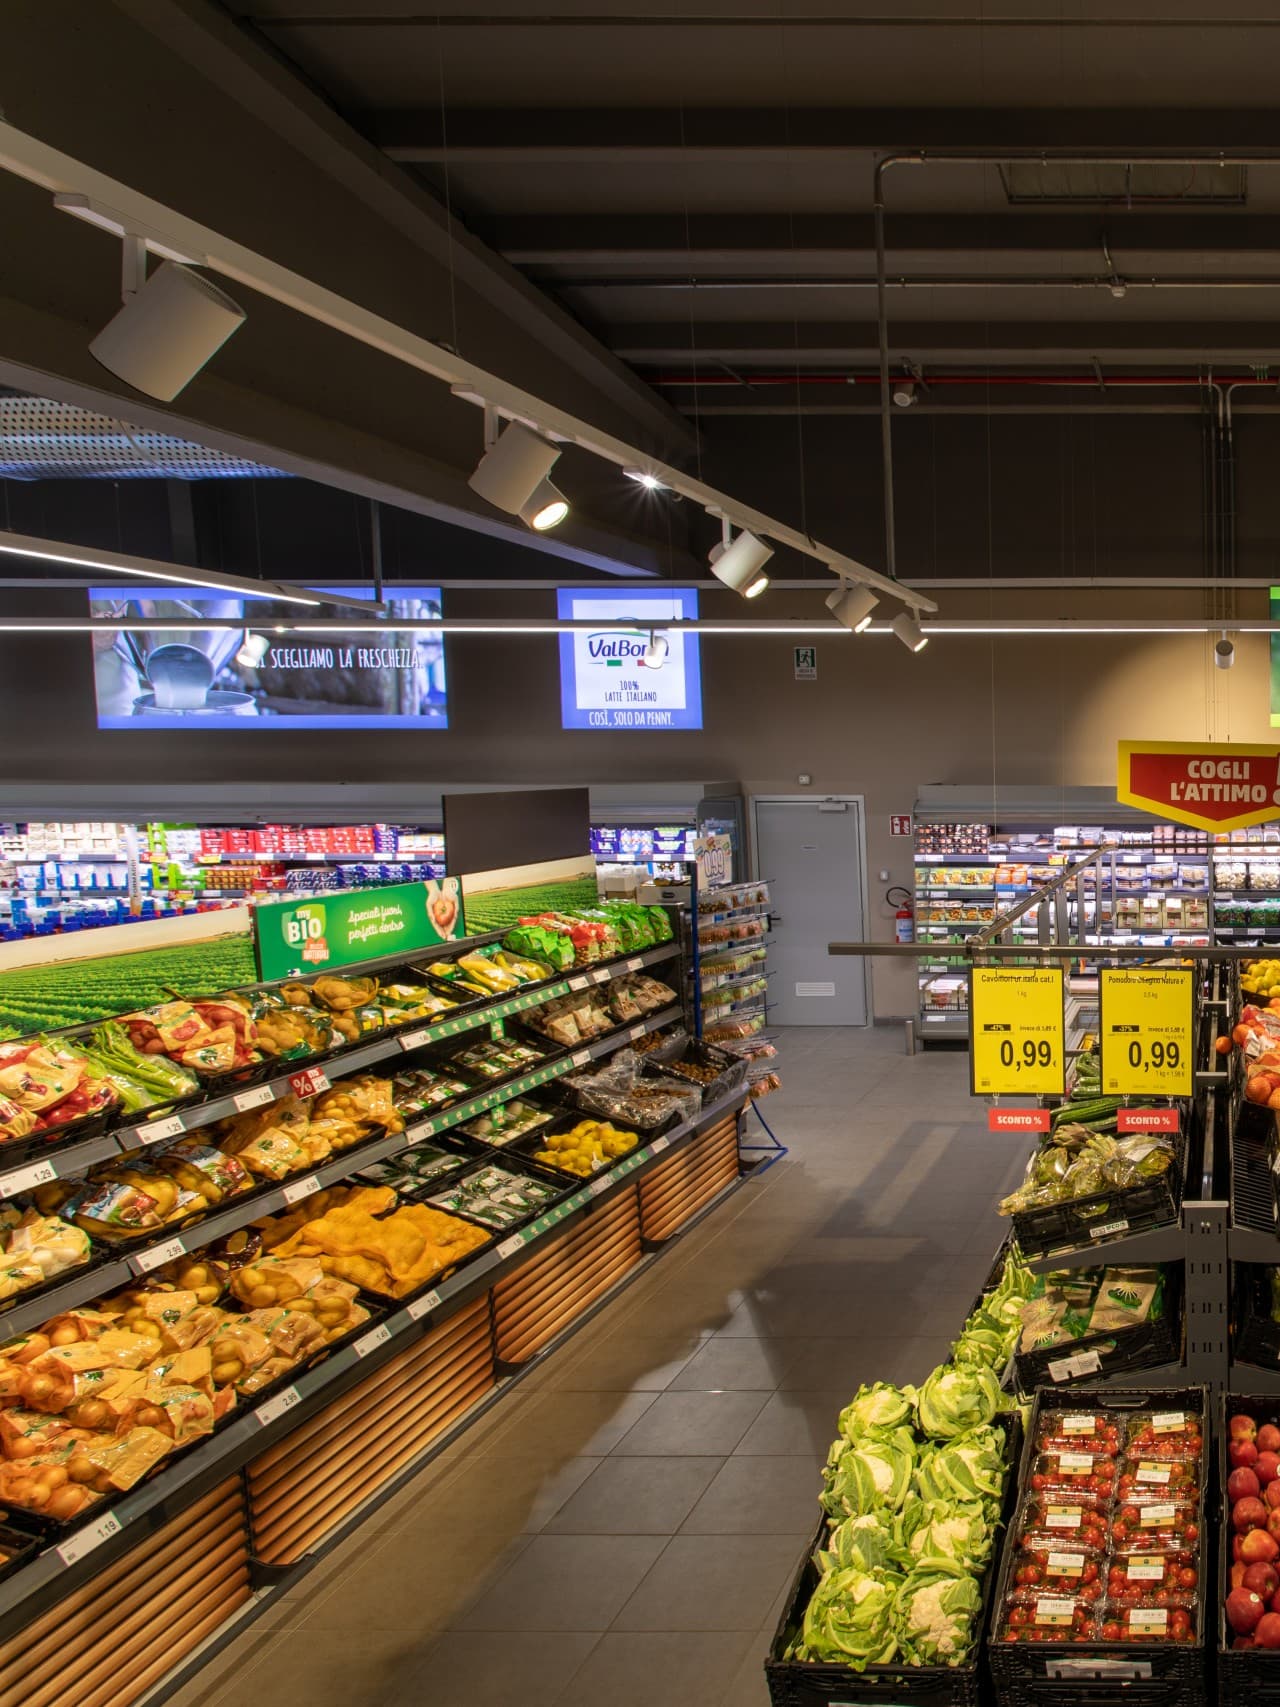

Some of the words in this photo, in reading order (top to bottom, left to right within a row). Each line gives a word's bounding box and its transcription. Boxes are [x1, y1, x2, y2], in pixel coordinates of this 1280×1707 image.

[271, 648, 334, 669] SCEGLIAMO
[339, 648, 353, 669] LA
[619, 680, 639, 691] 100%
[604, 691, 623, 702] LATTE
[626, 691, 658, 702] ITALIANO
[589, 709, 613, 727] COSÌ,
[613, 712, 633, 726] SOLO
[634, 712, 646, 726] DA
[646, 711, 676, 726] PENNY.
[1187, 760, 1251, 780] COGLI
[287, 917, 322, 943] BIO
[1000, 1039, 1052, 1072] 0,99
[1128, 1040, 1180, 1073] 0,99
[166, 1121, 183, 1134] 1.29
[997, 1115, 1032, 1126] SCONTO
[1125, 1115, 1161, 1126] SCONTO
[33, 1168, 53, 1184] 1.29
[166, 1244, 183, 1259] 2.99
[281, 1392, 299, 1407] 2.99
[96, 1519, 118, 1539] 1.19
